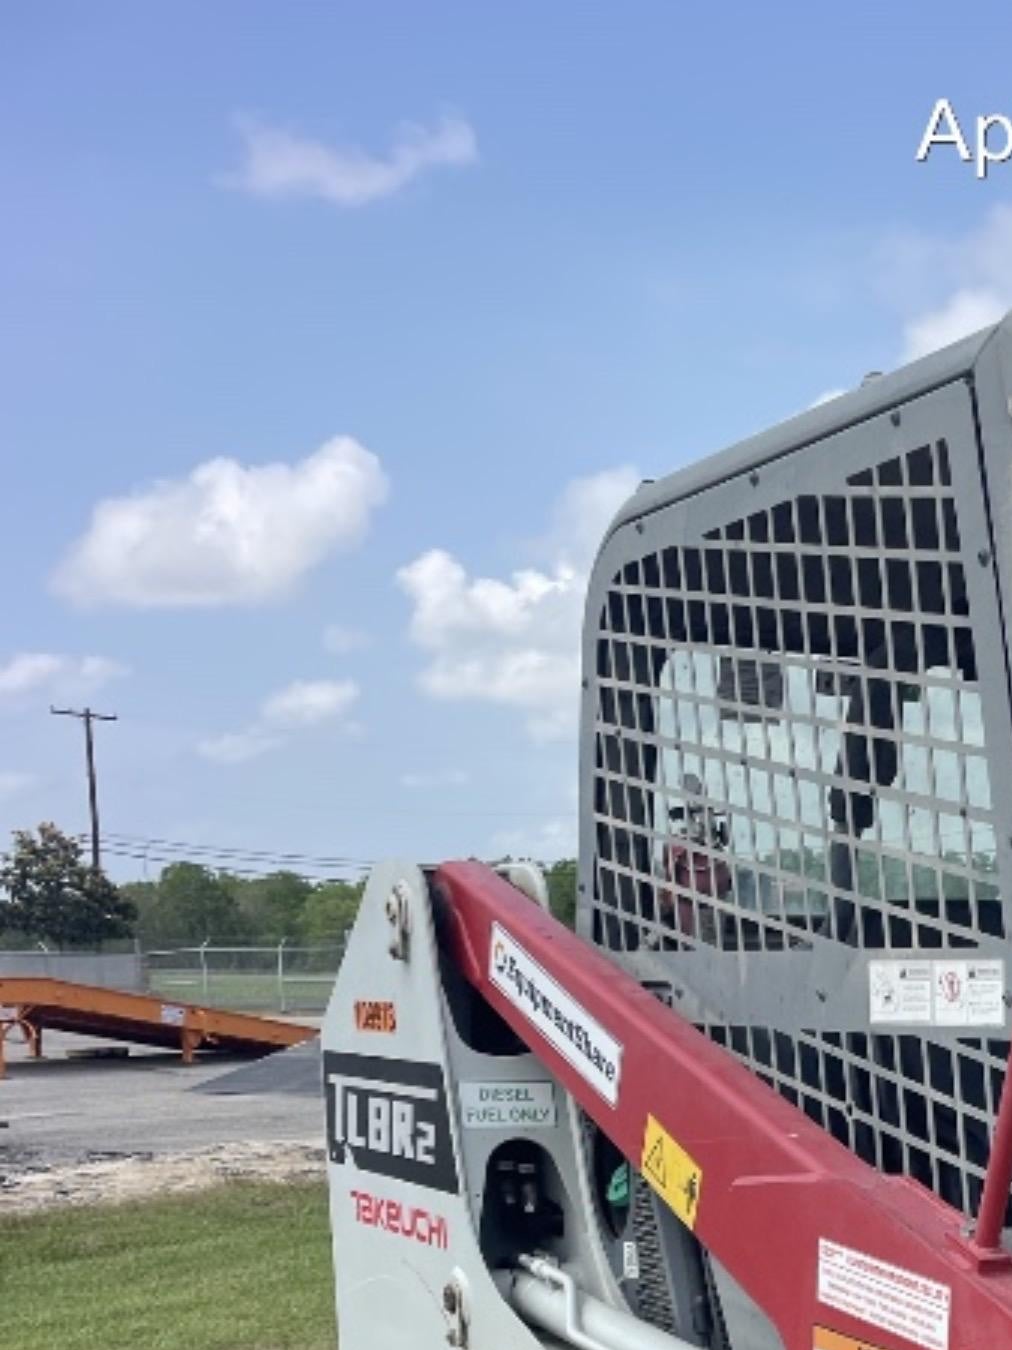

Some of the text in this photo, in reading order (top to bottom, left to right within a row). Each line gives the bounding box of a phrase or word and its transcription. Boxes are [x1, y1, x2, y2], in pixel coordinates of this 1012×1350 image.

[507, 955, 616, 1081] EquipmentShare
[479, 1087, 535, 1102] DIESEL
[466, 1106, 550, 1123] FUEL ONLY
